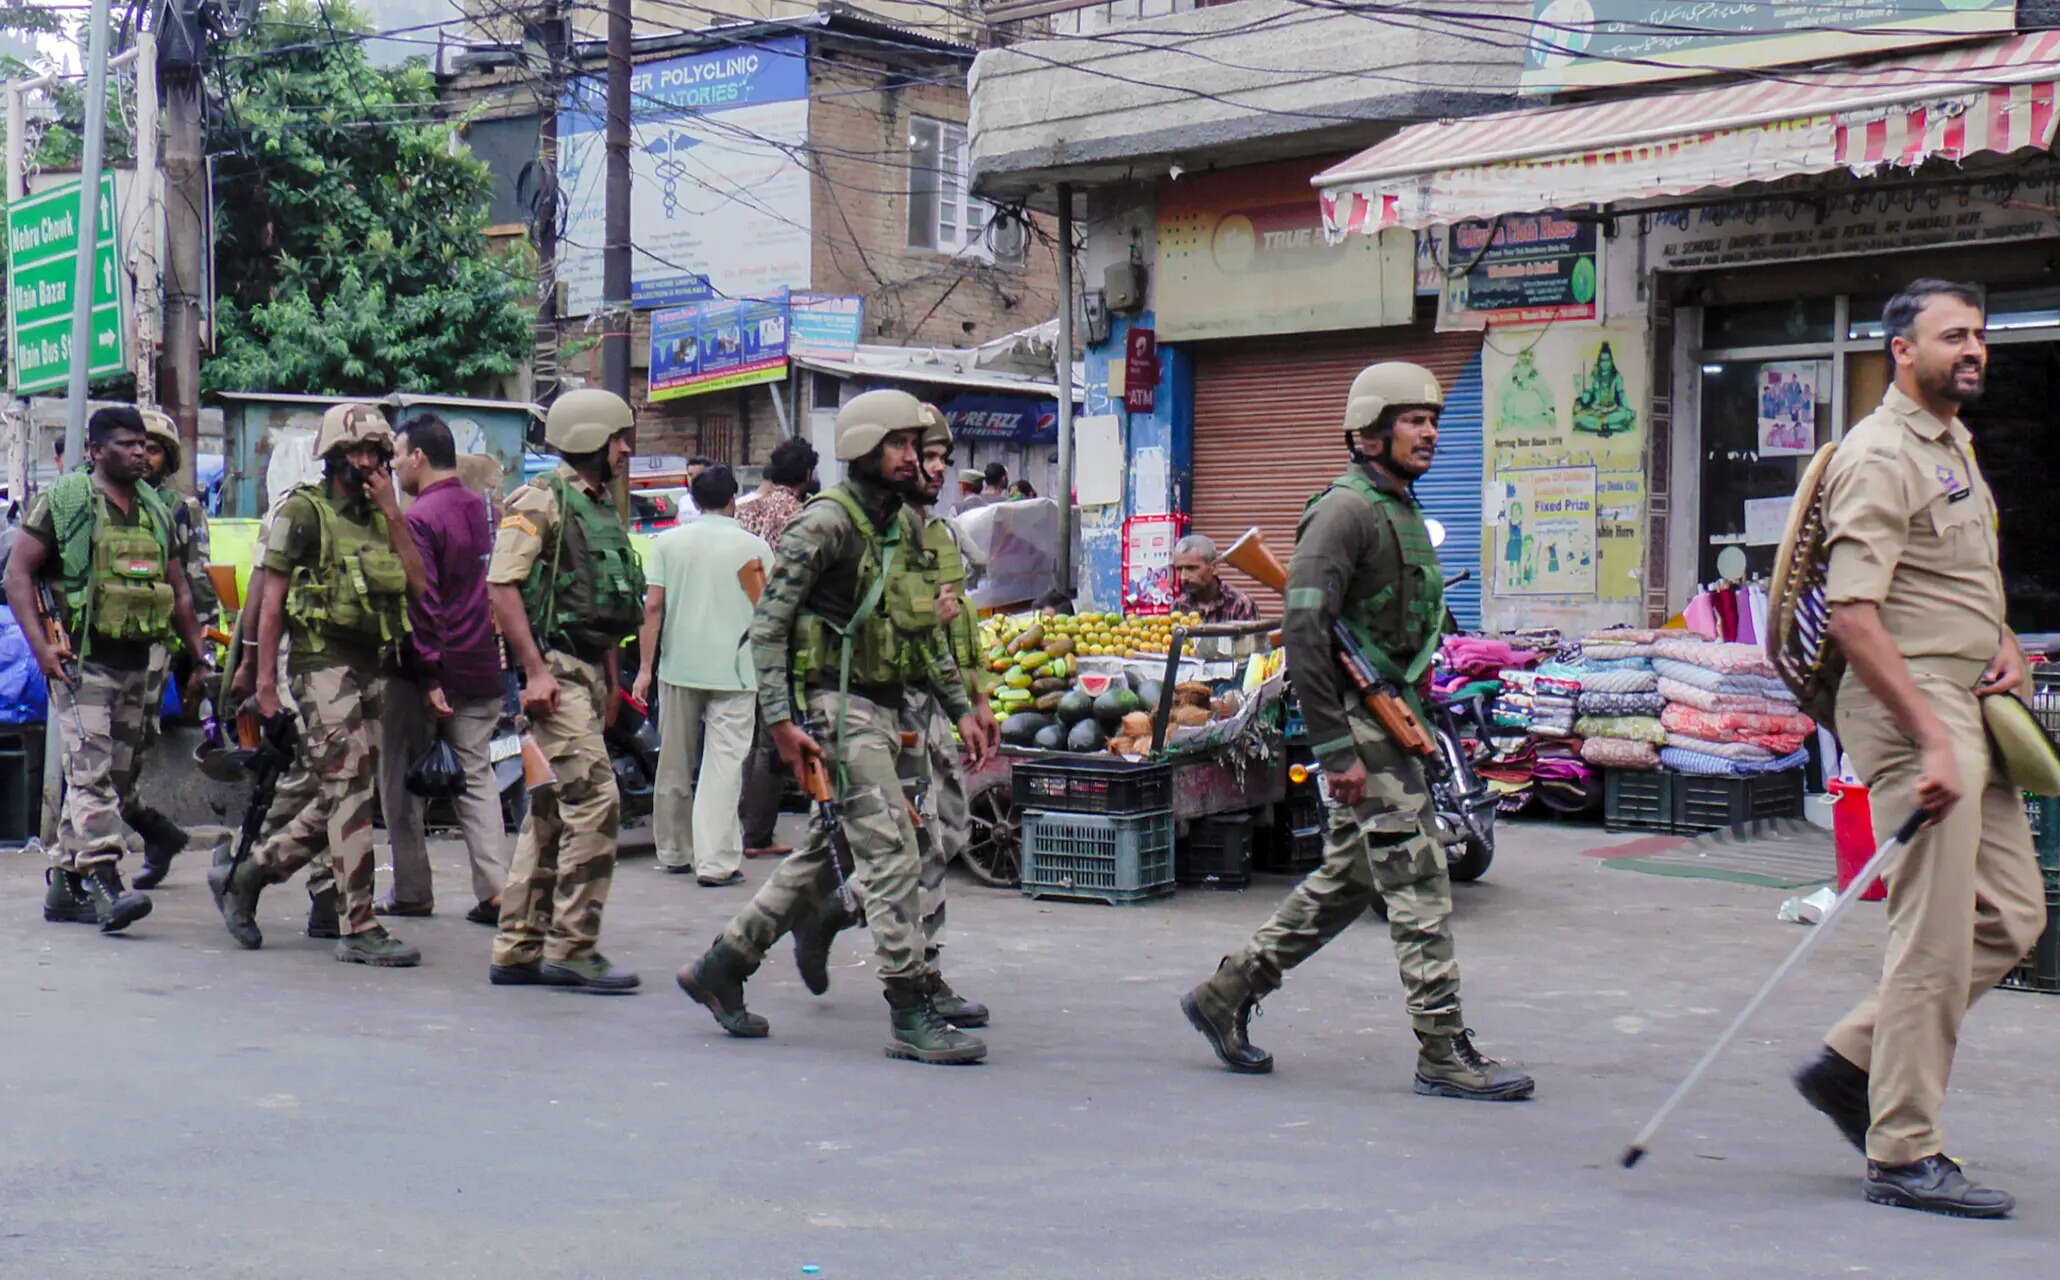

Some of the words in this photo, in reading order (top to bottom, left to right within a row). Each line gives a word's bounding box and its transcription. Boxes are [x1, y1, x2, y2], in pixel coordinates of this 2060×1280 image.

[660, 55, 759, 89] POLYCLINIC
[12, 223, 40, 252] Nehru
[41, 210, 74, 243] Chowk
[1263, 228, 1312, 250] TRUE
[15, 284, 38, 312] Main
[39, 280, 67, 306] Bazar
[19, 343, 41, 370] Main
[41, 339, 59, 365] Bus
[61, 333, 73, 360] St
[1130, 389, 1153, 405] ATM
[986, 412, 1023, 429] FIZZ
[1534, 499, 1562, 512] Fixed
[1565, 498, 1590, 511] Prize
